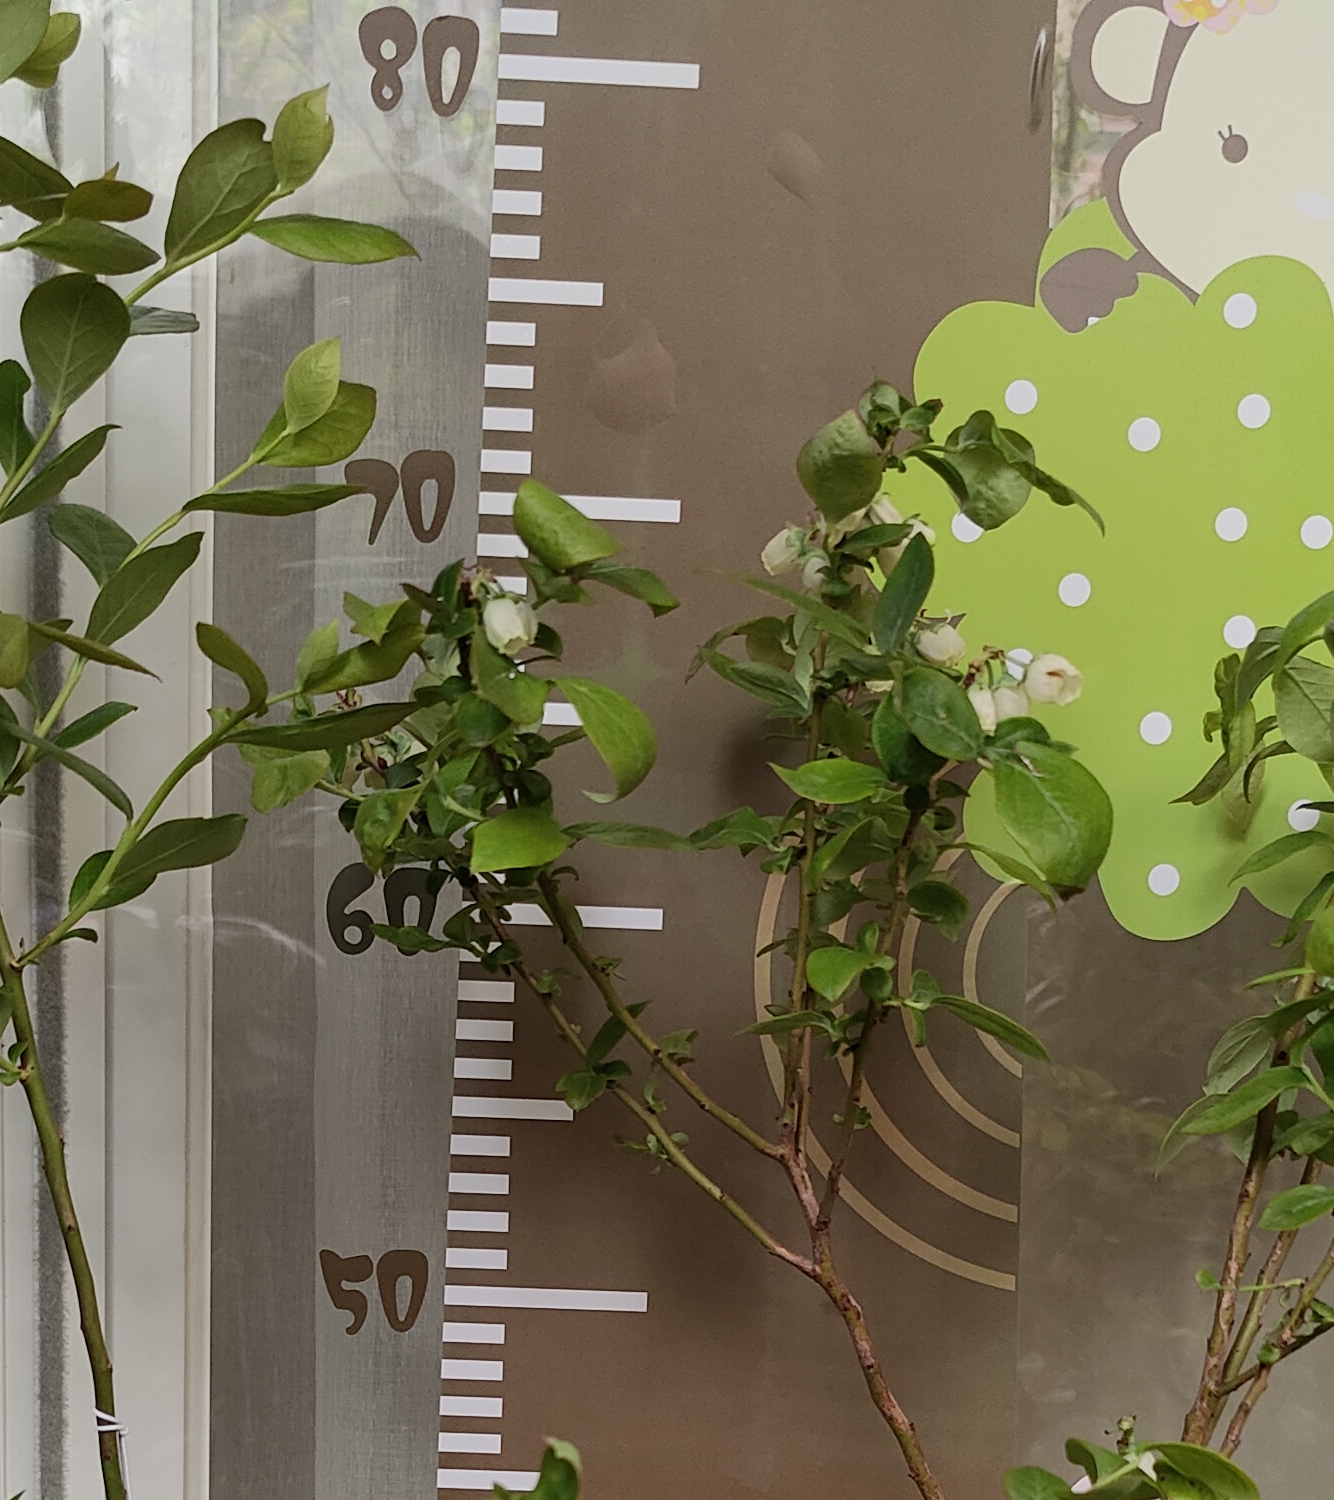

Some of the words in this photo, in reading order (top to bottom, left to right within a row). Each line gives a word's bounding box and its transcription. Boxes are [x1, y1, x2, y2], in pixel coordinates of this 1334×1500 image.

[358, 5, 480, 118] 80
[344, 448, 456, 546] 70
[326, 862, 441, 957] 60
[319, 1248, 429, 1336] 50
